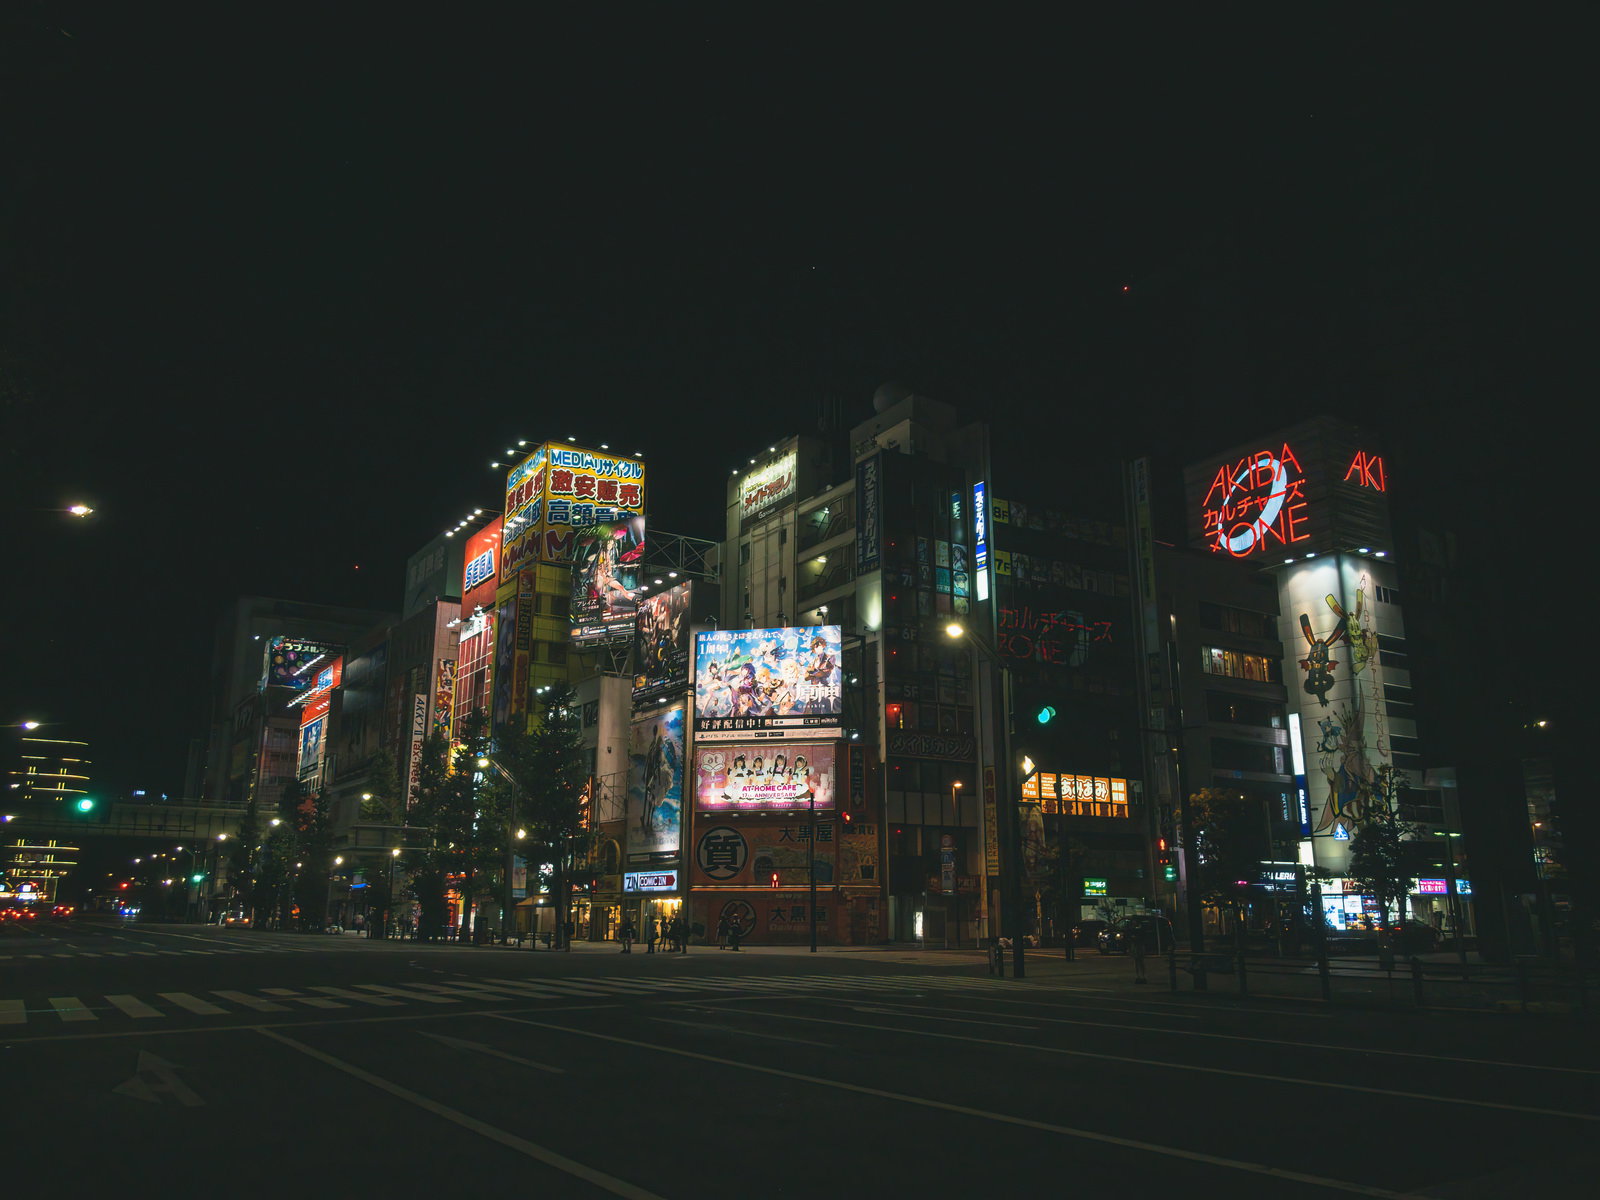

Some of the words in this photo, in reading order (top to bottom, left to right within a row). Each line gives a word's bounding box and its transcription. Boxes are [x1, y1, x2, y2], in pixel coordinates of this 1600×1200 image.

[550, 448, 643, 479] MEDIAリサイクル
[1203, 443, 1302, 506] AKIBA
[550, 469, 642, 507] 激安販売
[1203, 479, 1306, 530] カルチャーズ
[993, 506, 1009, 521] 8F
[1205, 502, 1311, 558] ZONE
[464, 548, 495, 594] SEGA
[995, 558, 1011, 572] 7F
[416, 696, 425, 729] AKKY
[1061, 779, 1107, 800] あみあみ
[703, 834, 742, 873] 質
[626, 874, 638, 889] ZIN
[640, 876, 658, 885] COMIC
